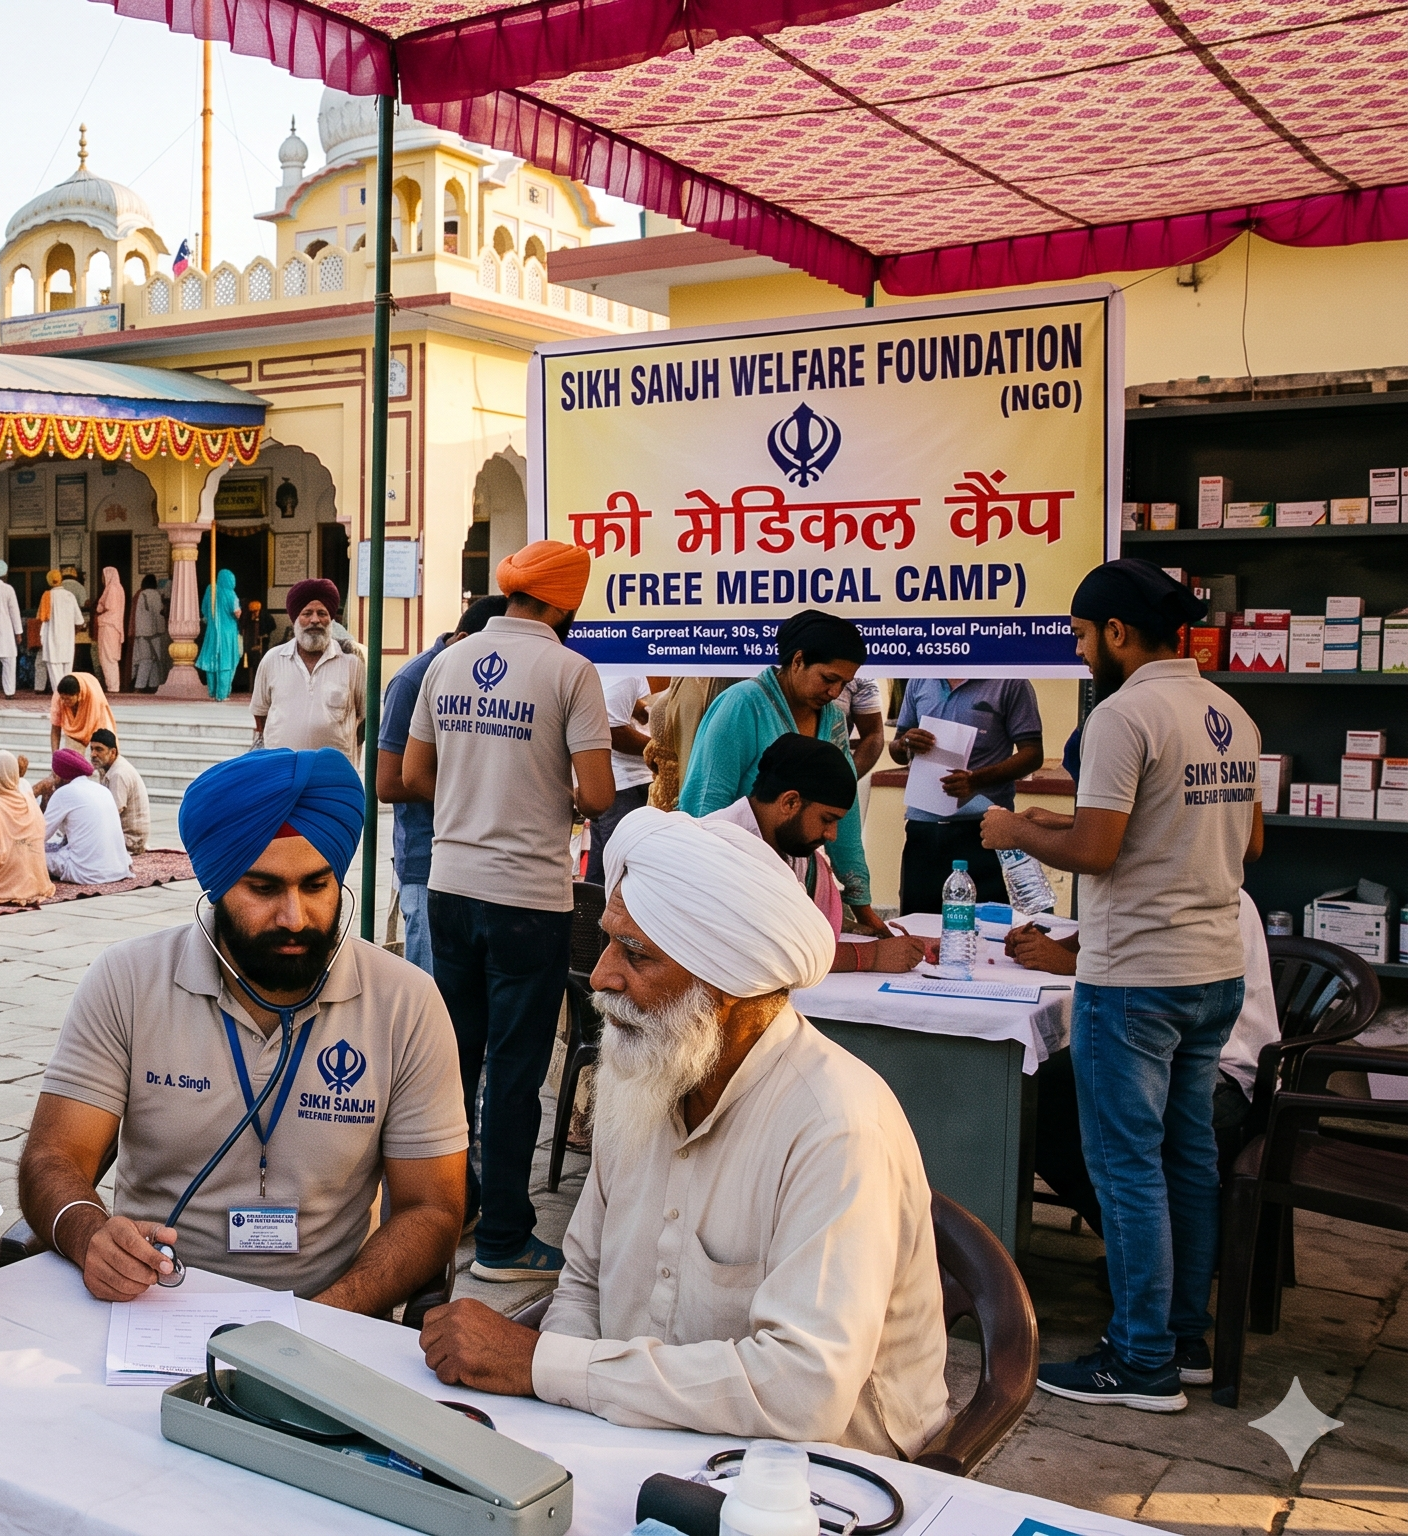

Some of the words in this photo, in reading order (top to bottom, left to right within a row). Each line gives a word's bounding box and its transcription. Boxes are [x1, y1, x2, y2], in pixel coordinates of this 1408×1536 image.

[560, 367, 621, 412] SIKH
[630, 358, 720, 406] SANJH
[729, 344, 865, 398] WELFARE
[877, 322, 1082, 385] FOUNDATION
[1000, 379, 1083, 419] (NGO)
[674, 485, 921, 556] मेडिकल
[944, 468, 1075, 548] कैंप
[605, 571, 703, 614] (FREE
[716, 566, 882, 606] MEDICAL
[894, 562, 1027, 609] CAMP)
[693, 625, 728, 640] Kaur,
[647, 643, 697, 656] Serman
[437, 694, 472, 715] SIKH
[476, 696, 535, 724] SANJH
[1184, 761, 1218, 788] SIKH
[146, 1070, 162, 1085] Dr.
[164, 1073, 176, 1087] A.
[178, 1074, 211, 1093] Singh
[299, 1092, 331, 1110] SIKH
[334, 1097, 376, 1113] SANJH
